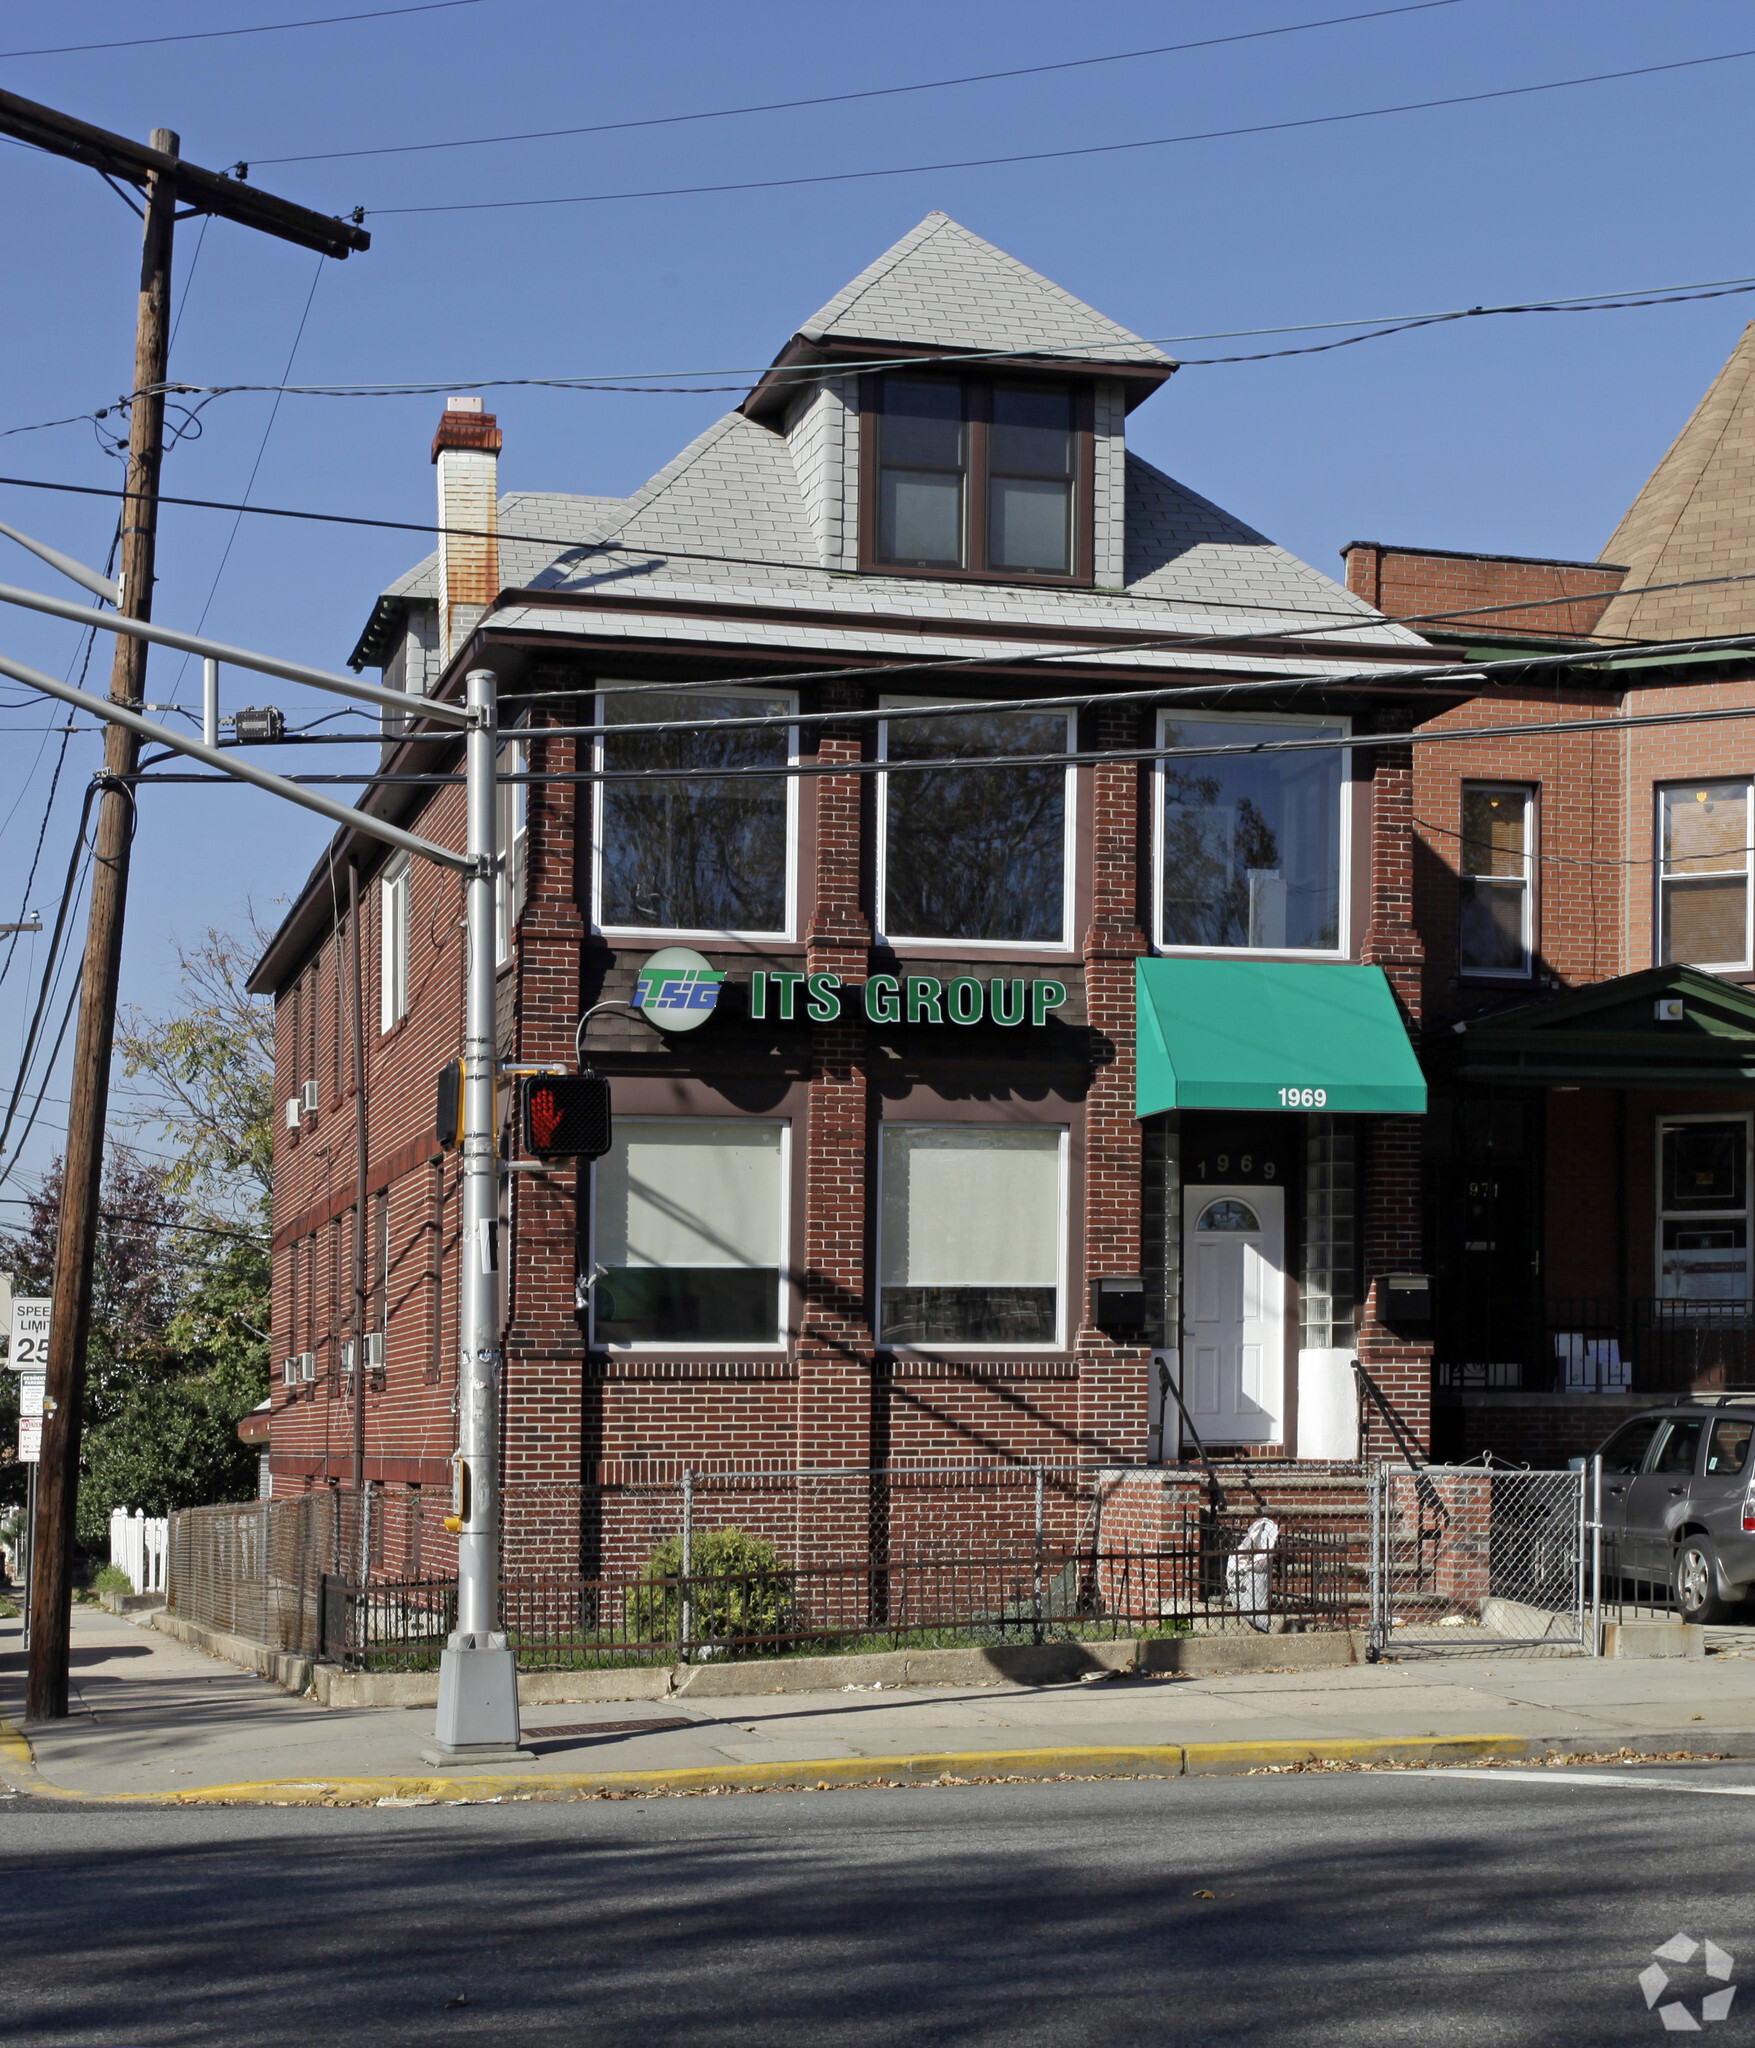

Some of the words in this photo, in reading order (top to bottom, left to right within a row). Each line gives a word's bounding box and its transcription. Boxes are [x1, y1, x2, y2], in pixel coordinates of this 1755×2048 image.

[751, 971, 841, 1022] ITS
[865, 974, 1067, 1026] GROUP
[1277, 1087, 1328, 1108] 1969
[1197, 1154, 1276, 1180] 1969
[17, 1306, 51, 1317] SPEE
[16, 1338, 49, 1363] 25
